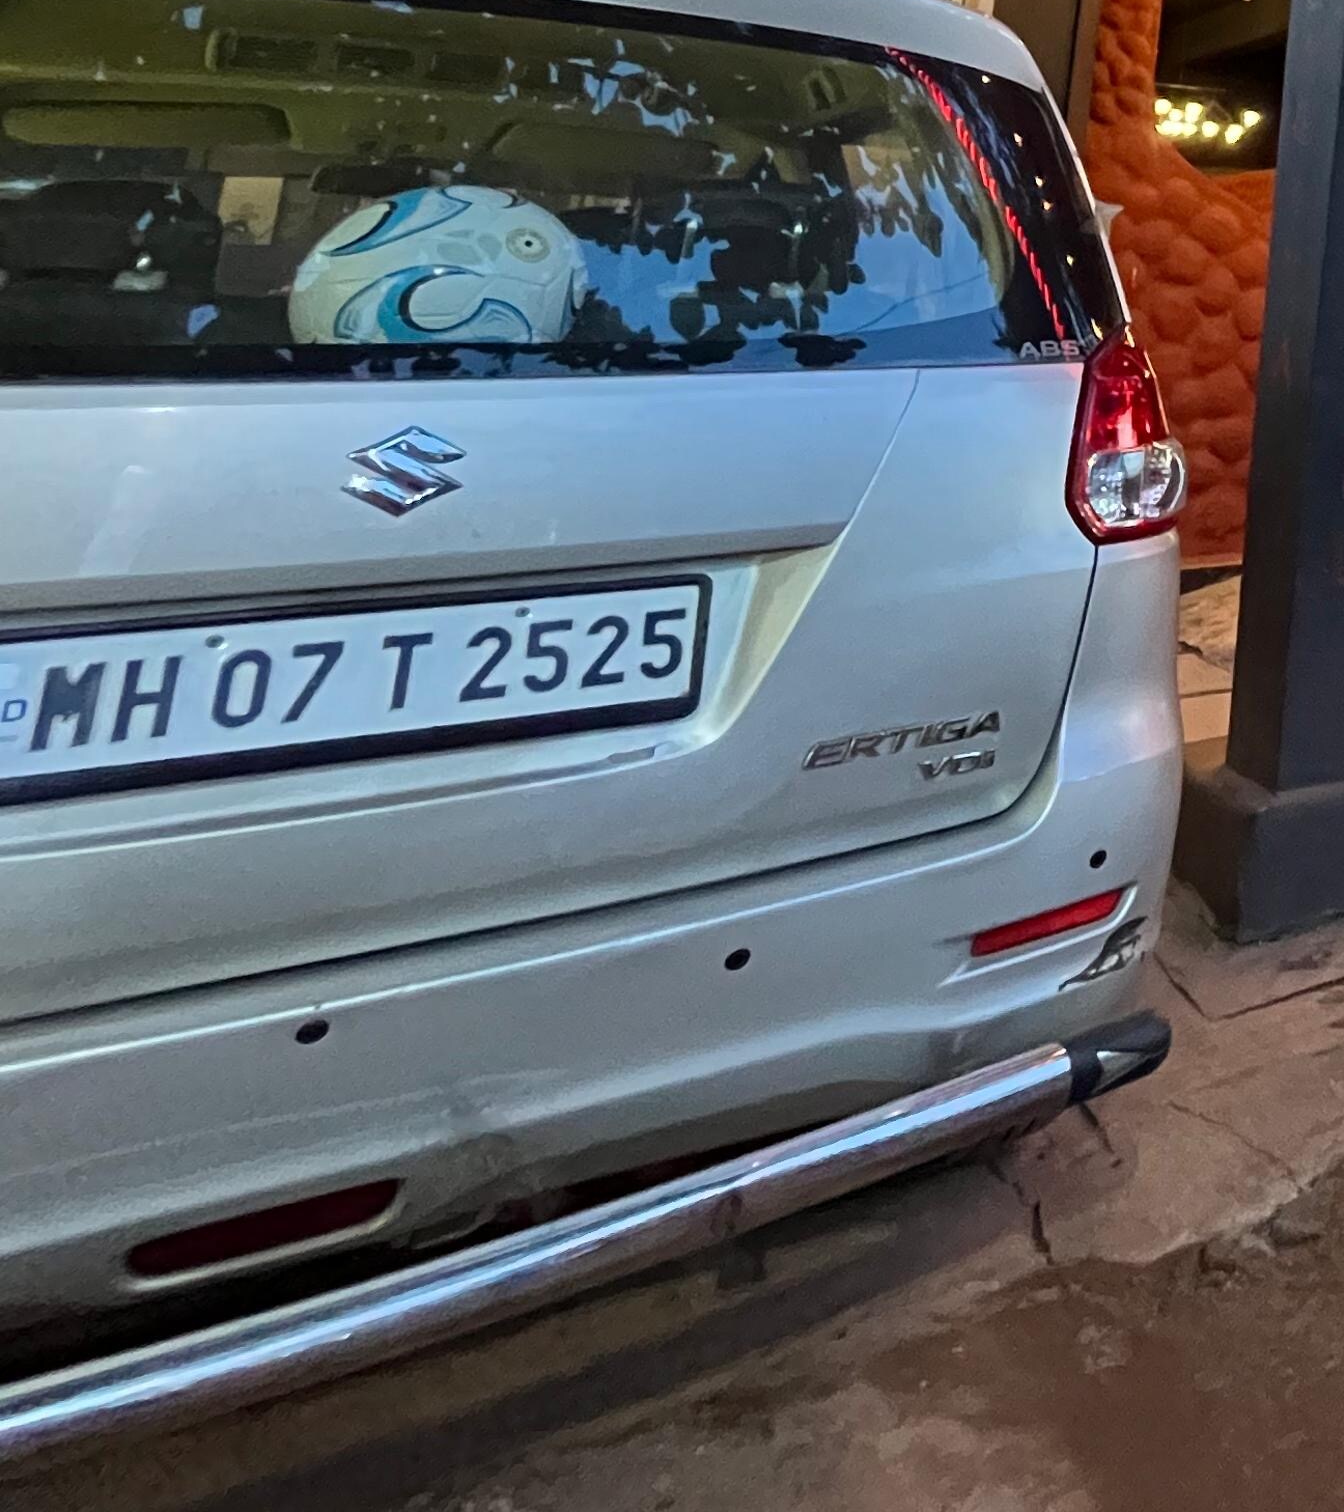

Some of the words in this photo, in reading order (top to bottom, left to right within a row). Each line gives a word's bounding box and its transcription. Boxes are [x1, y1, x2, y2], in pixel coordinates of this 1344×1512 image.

[1019, 339, 1080, 360] ABS
[29, 654, 184, 753] MH
[210, 640, 346, 729] 07
[383, 632, 434, 711] T
[458, 607, 688, 703] 2525
[802, 710, 1000, 771] ERTIGA
[916, 748, 996, 781] VDI
